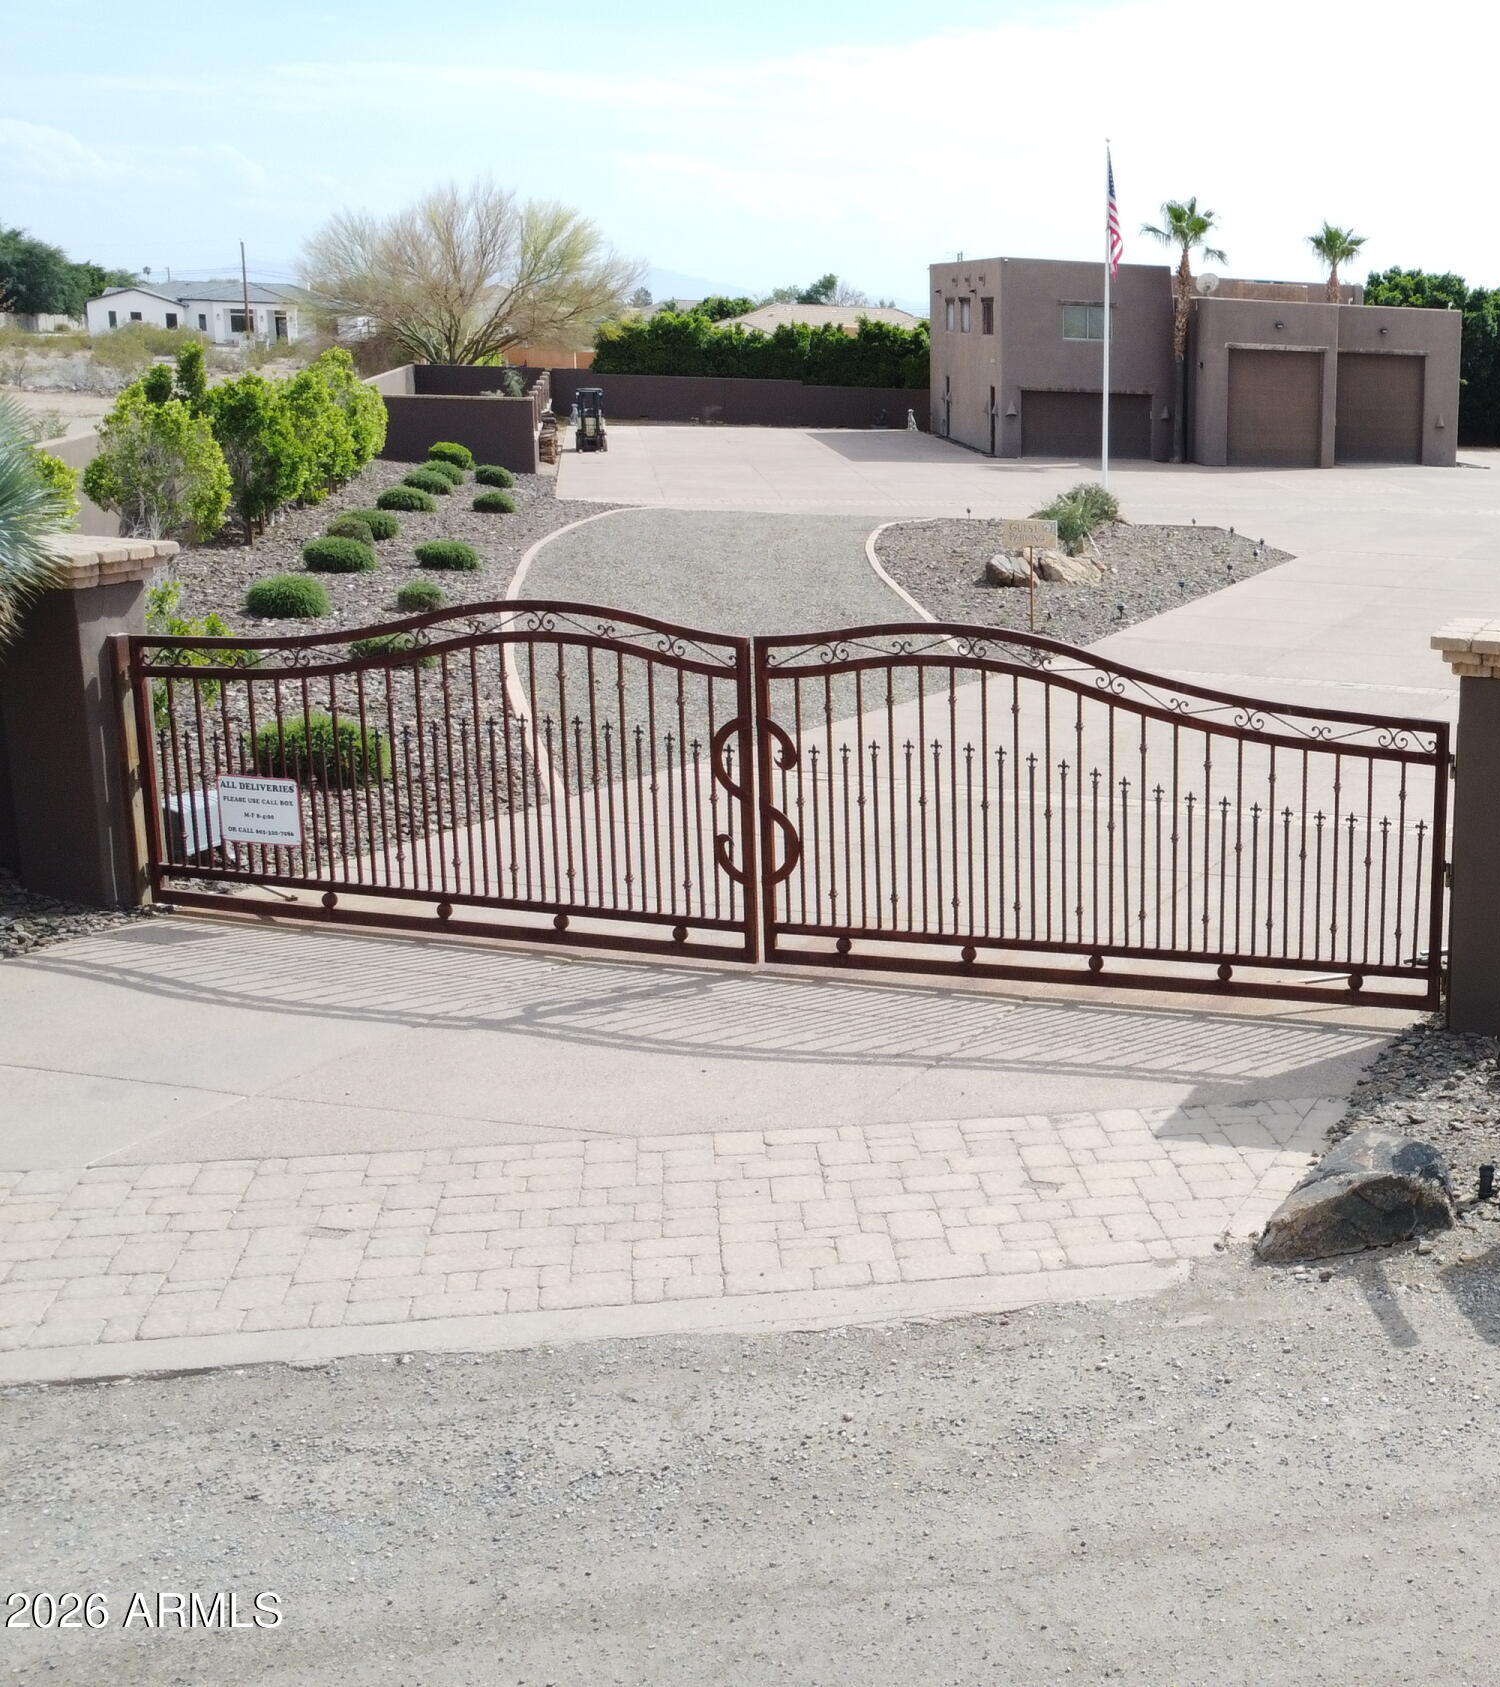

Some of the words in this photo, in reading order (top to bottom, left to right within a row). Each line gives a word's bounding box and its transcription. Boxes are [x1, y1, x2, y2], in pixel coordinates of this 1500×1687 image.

[1009, 523, 1037, 533] GUEST
[220, 780, 237, 790] ALL
[239, 782, 295, 793] DELIVERIES
